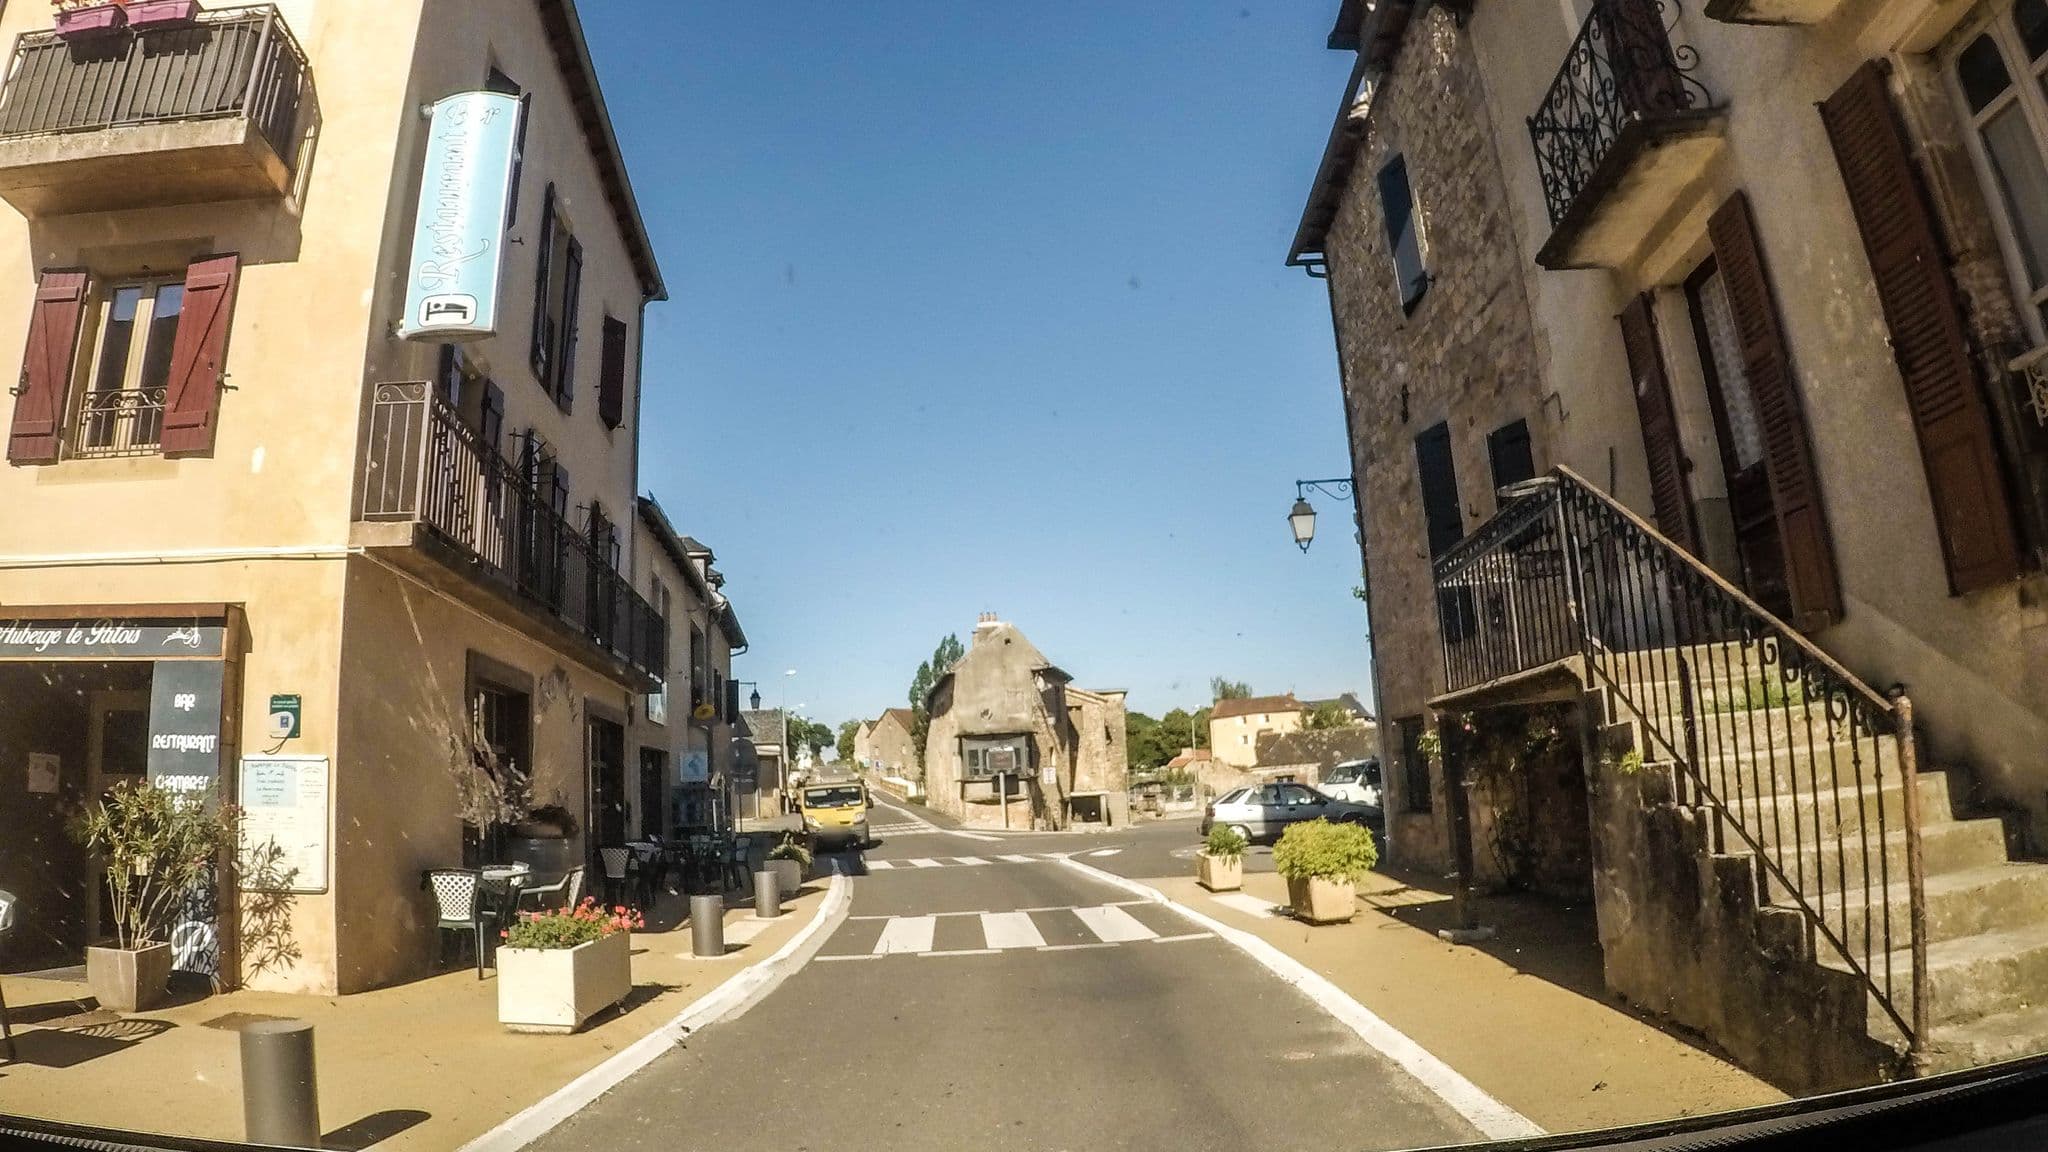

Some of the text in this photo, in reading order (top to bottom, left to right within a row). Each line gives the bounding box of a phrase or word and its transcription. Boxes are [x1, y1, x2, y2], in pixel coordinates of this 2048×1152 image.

[446, 101, 501, 128] Br
[417, 130, 490, 291] Restaurant
[65, 621, 83, 645] le
[85, 617, 142, 645] Patois
[174, 693, 196, 711] BAR
[152, 734, 217, 753] RESTAURANT
